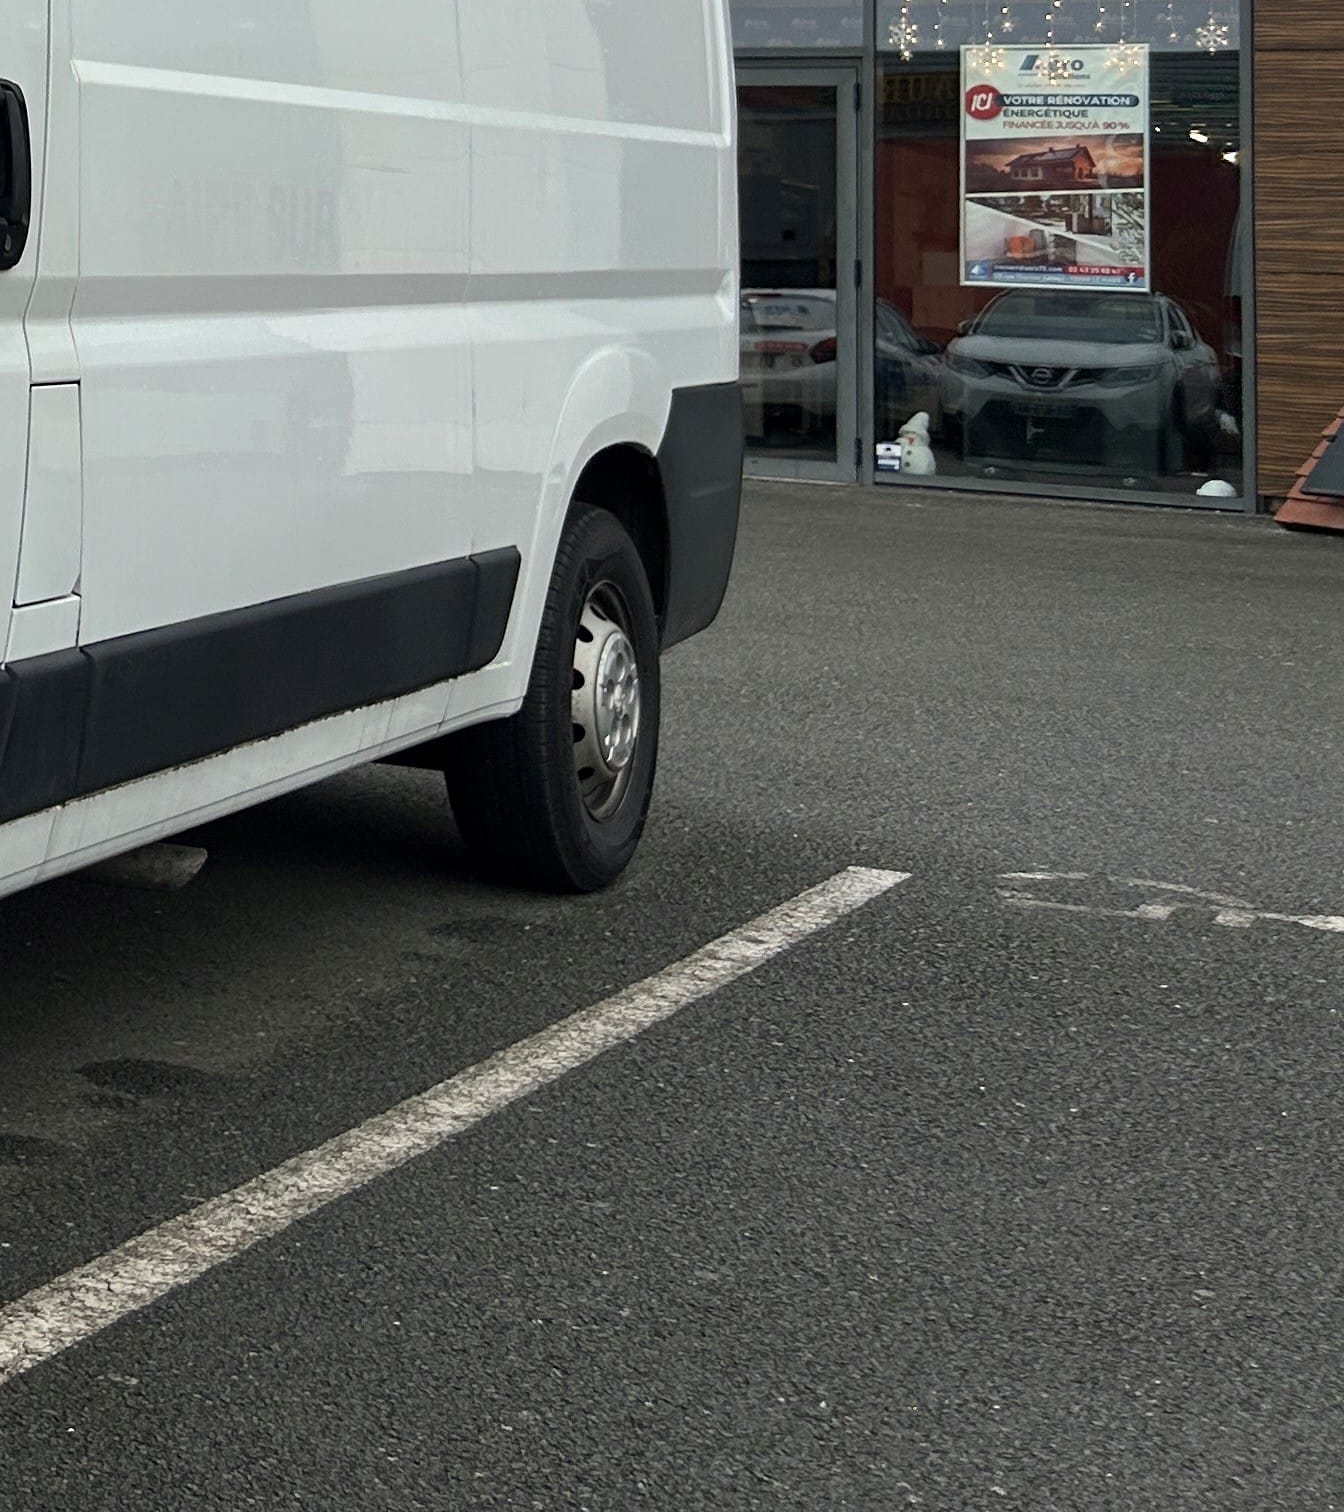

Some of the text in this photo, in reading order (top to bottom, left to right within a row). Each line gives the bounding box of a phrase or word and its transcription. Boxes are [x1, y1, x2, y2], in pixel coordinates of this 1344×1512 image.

[1003, 94, 1130, 105] VOTRE RÉNOVATION
[1003, 108, 1089, 118] ÉNERGÉTIQUE
[1003, 120, 1054, 129] FINANCÉE
